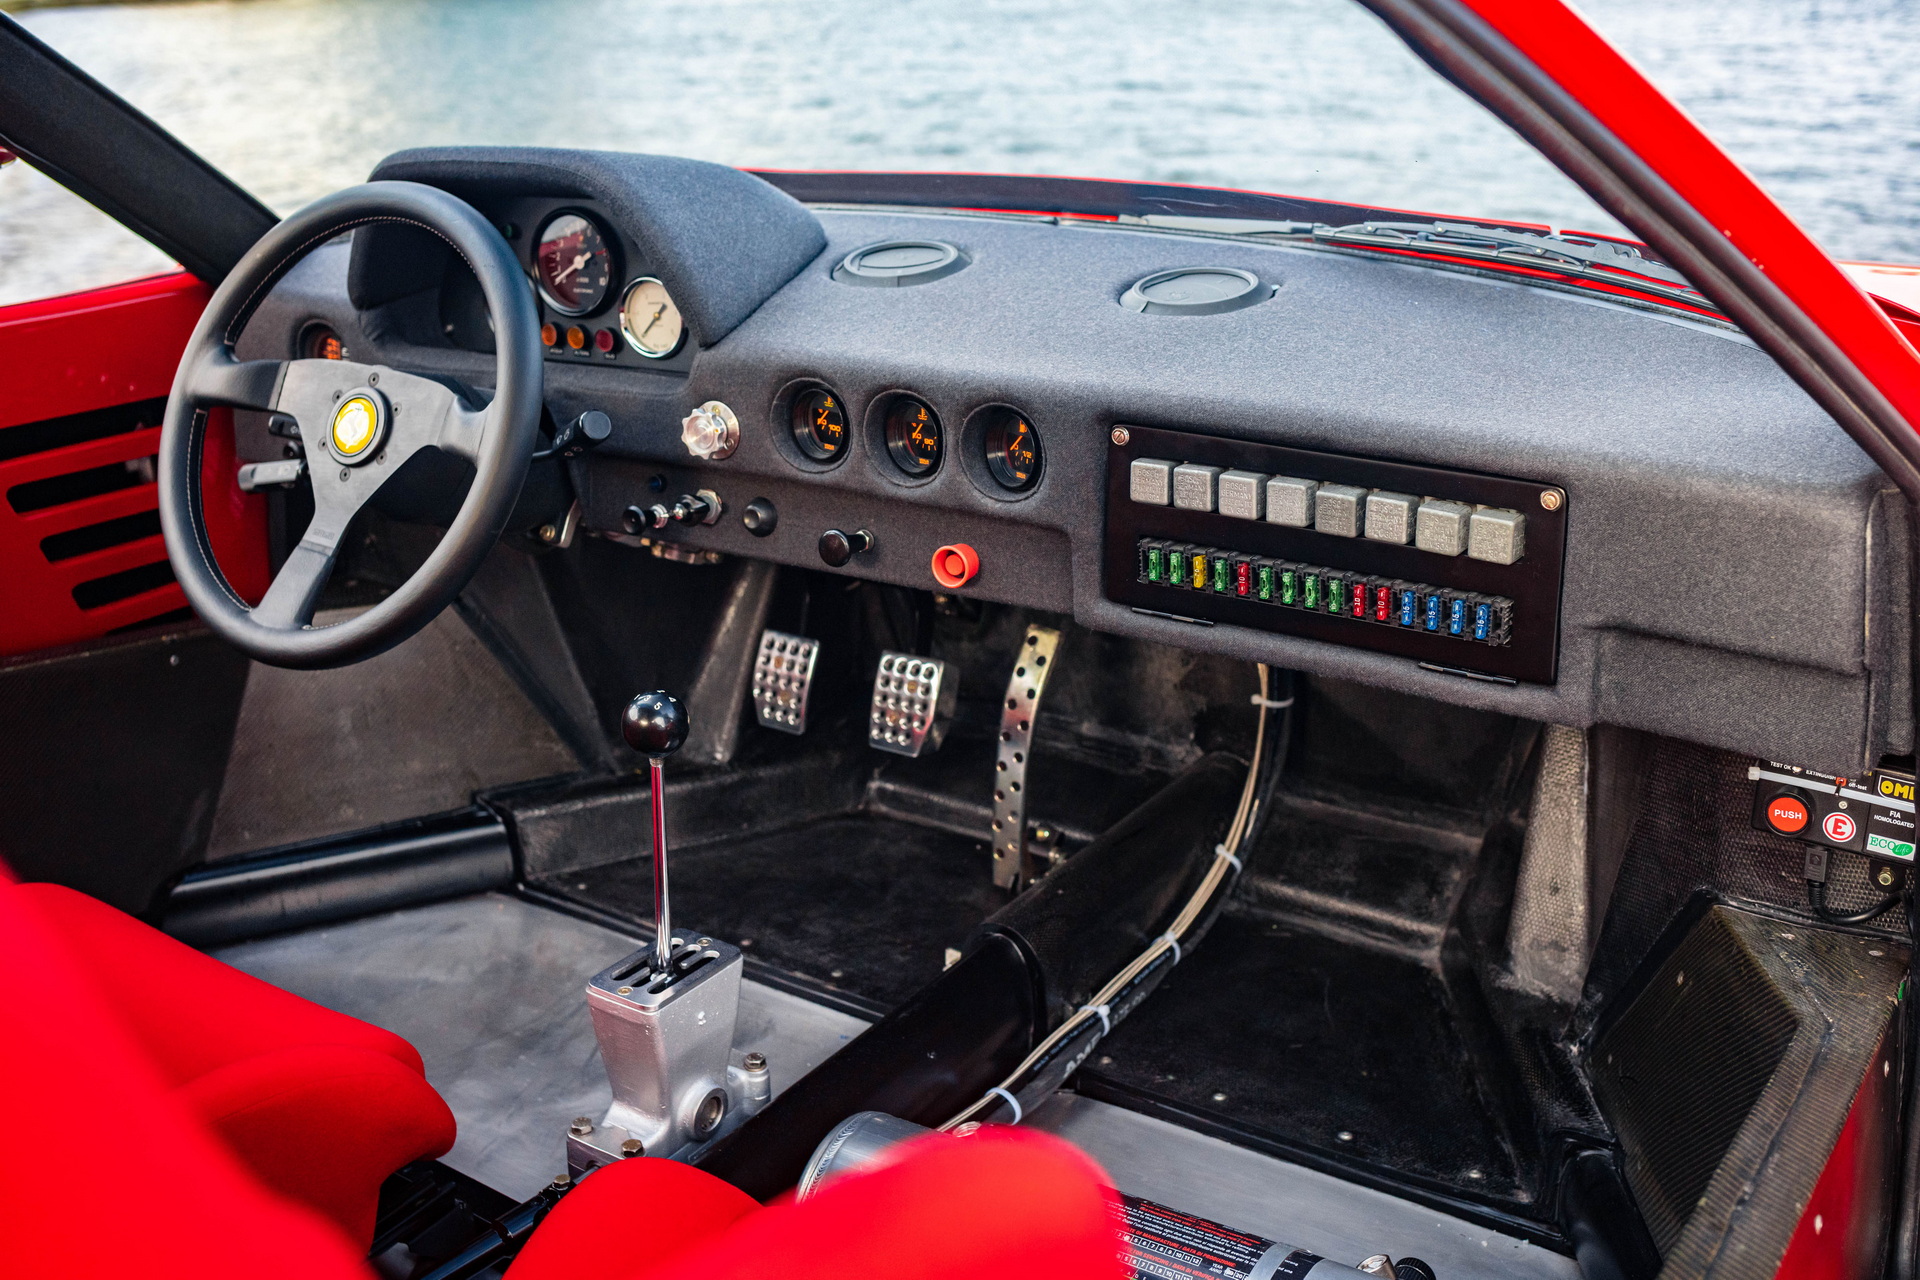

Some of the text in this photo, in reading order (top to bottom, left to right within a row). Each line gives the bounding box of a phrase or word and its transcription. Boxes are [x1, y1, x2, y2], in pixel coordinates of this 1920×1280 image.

[1225, 481, 1247, 491] BOSCH
[1221, 489, 1252, 500] GERMANY
[1239, 576, 1245, 584] 10
[1354, 597, 1361, 606] 10
[1378, 600, 1384, 609] 10
[1403, 606, 1410, 614] 15
[1428, 610, 1436, 619] 15
[1452, 614, 1459, 622] 15
[1477, 619, 1484, 627] 15
[654, 702, 662, 710] 5
[1770, 761, 1783, 769] TEST
[1774, 809, 1802, 820] PUSH
[1889, 810, 1901, 819] FIA
[1874, 814, 1915, 829] HOMOLOGATED
[1832, 818, 1848, 836] E
[1869, 835, 1896, 851] ECO
